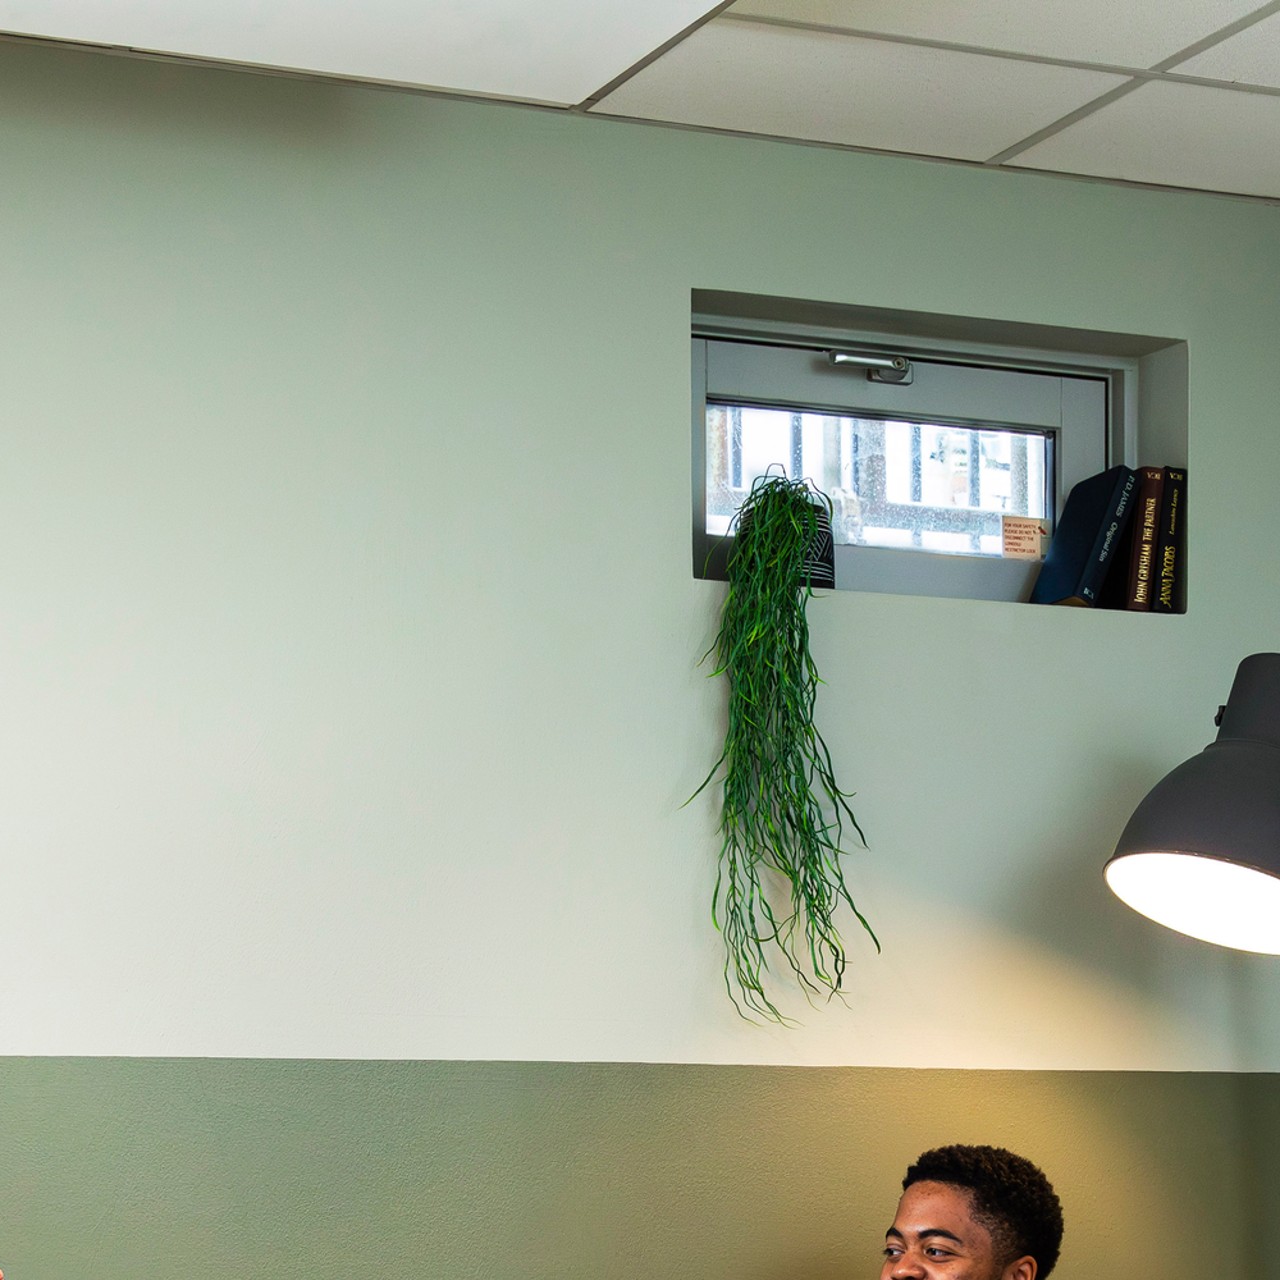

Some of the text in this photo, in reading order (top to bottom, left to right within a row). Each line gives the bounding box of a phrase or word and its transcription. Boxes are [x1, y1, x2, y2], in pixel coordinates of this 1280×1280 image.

[1125, 483, 1133, 491] D.
[1115, 490, 1130, 518] JAMES
[1103, 521, 1118, 552] Original
[1133, 497, 1157, 604] JOHN GRISHAM THE PARTNER
[1098, 551, 1108, 562] Sin
[1161, 545, 1176, 581] JACOBS
[1159, 579, 1174, 609] ANNA
